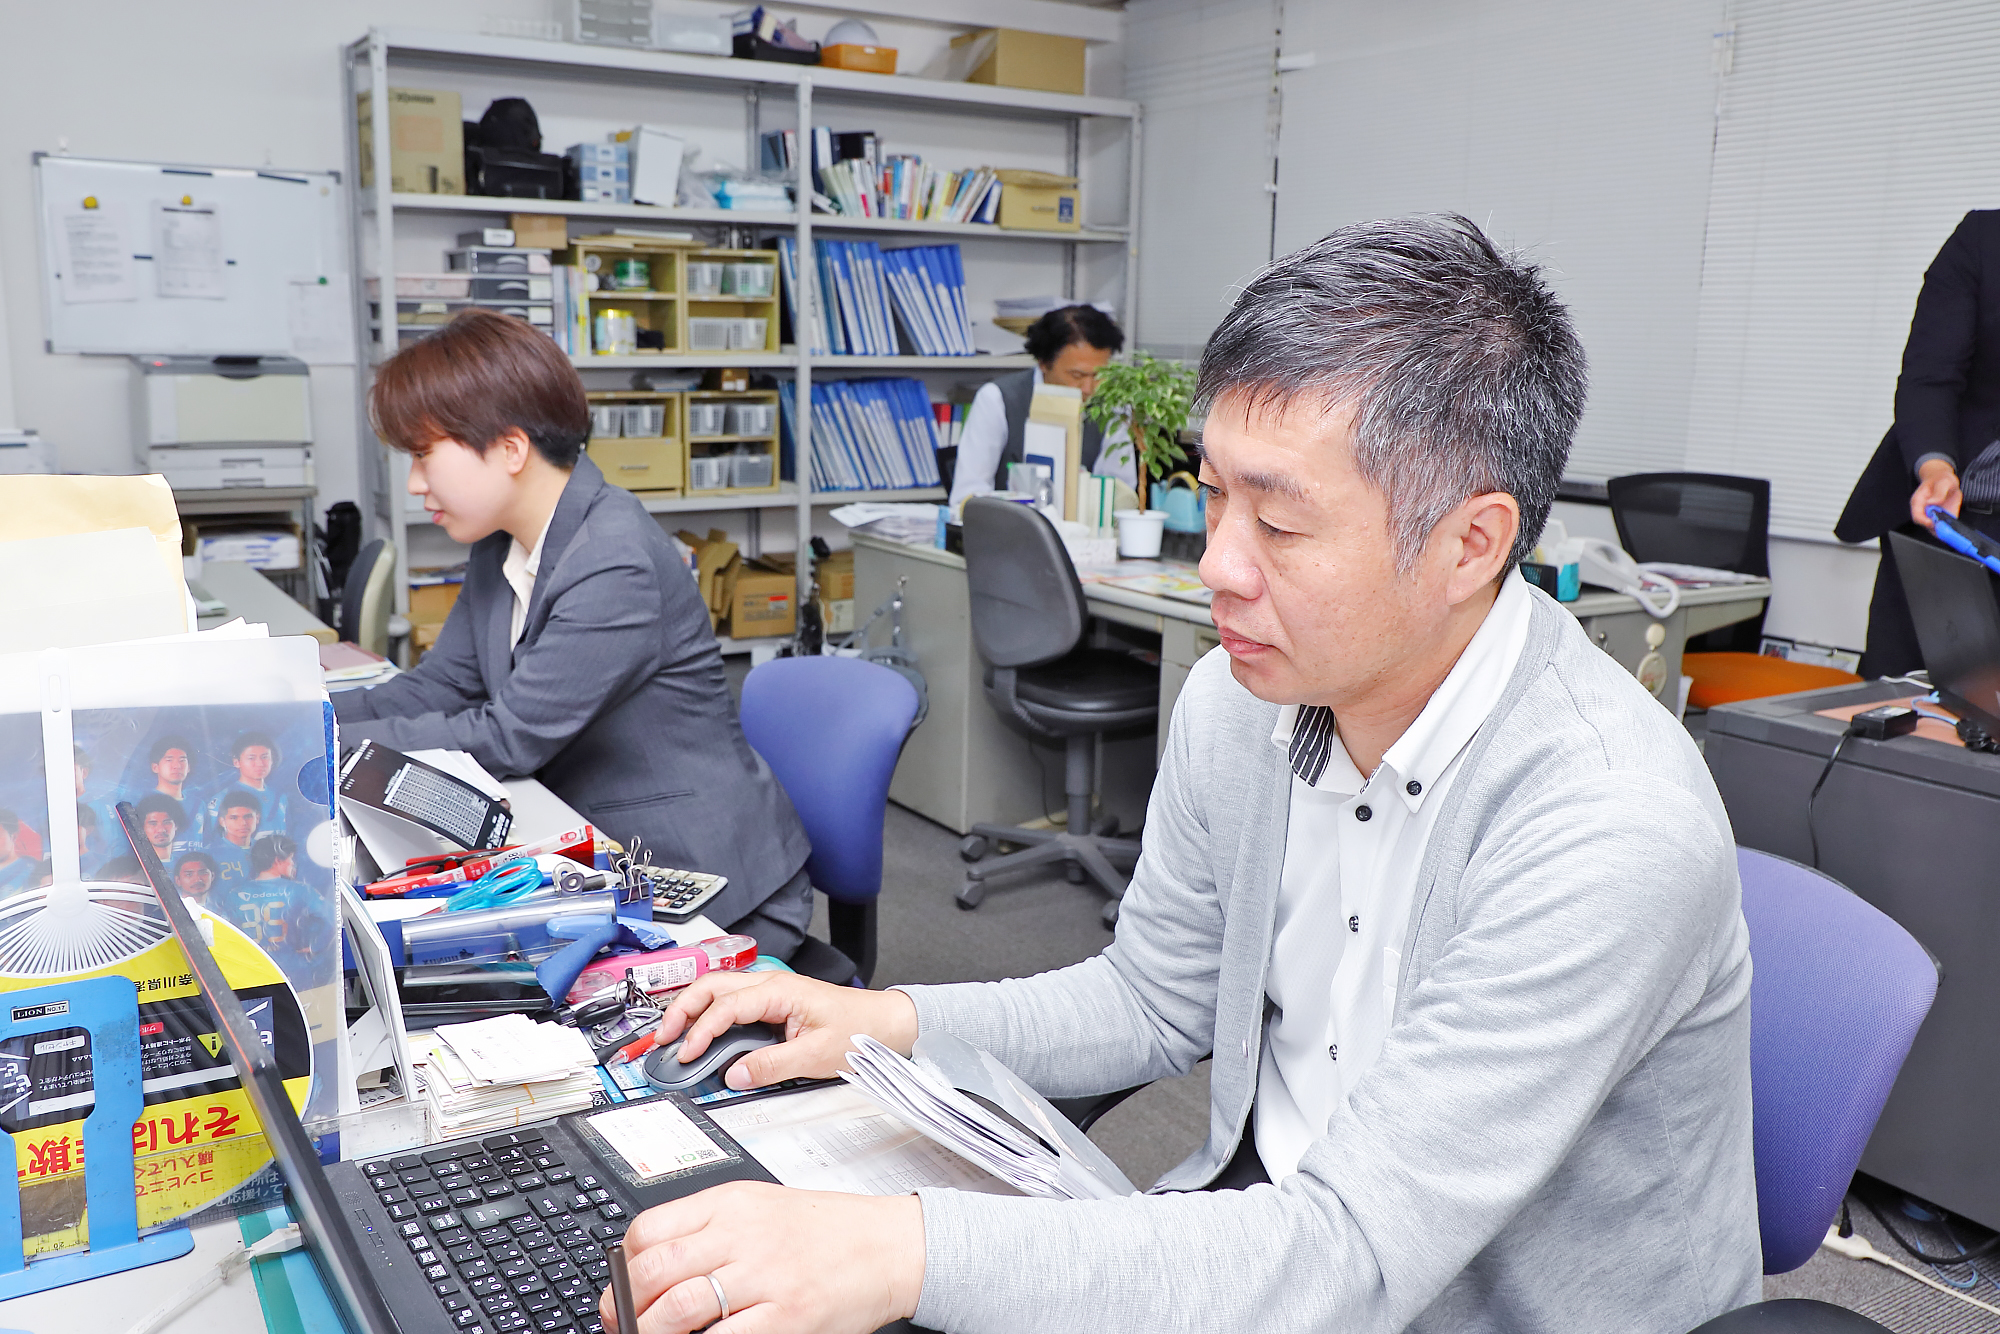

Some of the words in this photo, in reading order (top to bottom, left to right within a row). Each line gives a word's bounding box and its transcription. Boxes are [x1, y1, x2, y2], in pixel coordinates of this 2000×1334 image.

[220, 861, 244, 880] 24
[17, 1008, 43, 1018] LION
[142, 1052, 191, 1066] 今すぐ対処しなけ
[3, 1074, 32, 1094] ビー
[475, 1211, 487, 1222] Enter
[552, 1271, 563, 1279] L
[563, 1288, 576, 1297] K
[543, 1320, 556, 1328] U
